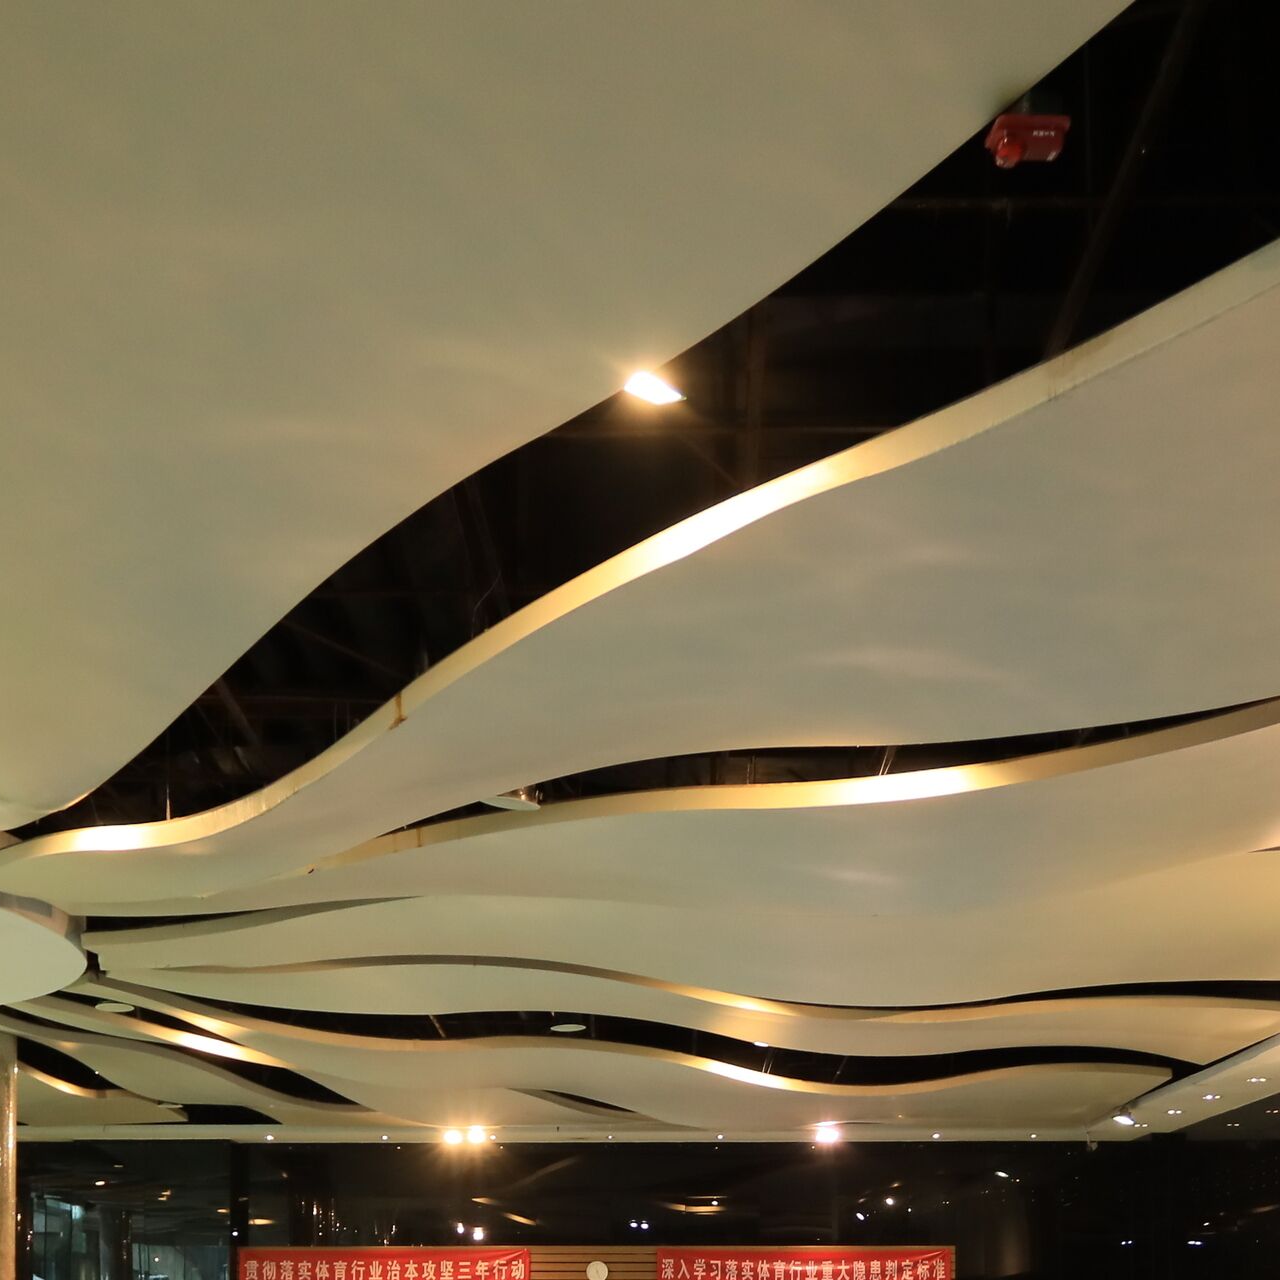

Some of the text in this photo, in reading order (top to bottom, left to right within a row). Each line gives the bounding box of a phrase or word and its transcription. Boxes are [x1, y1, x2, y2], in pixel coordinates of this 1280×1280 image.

[244, 1259, 526, 1280] 贯彻落实体育行业治本攻坚三年行动
